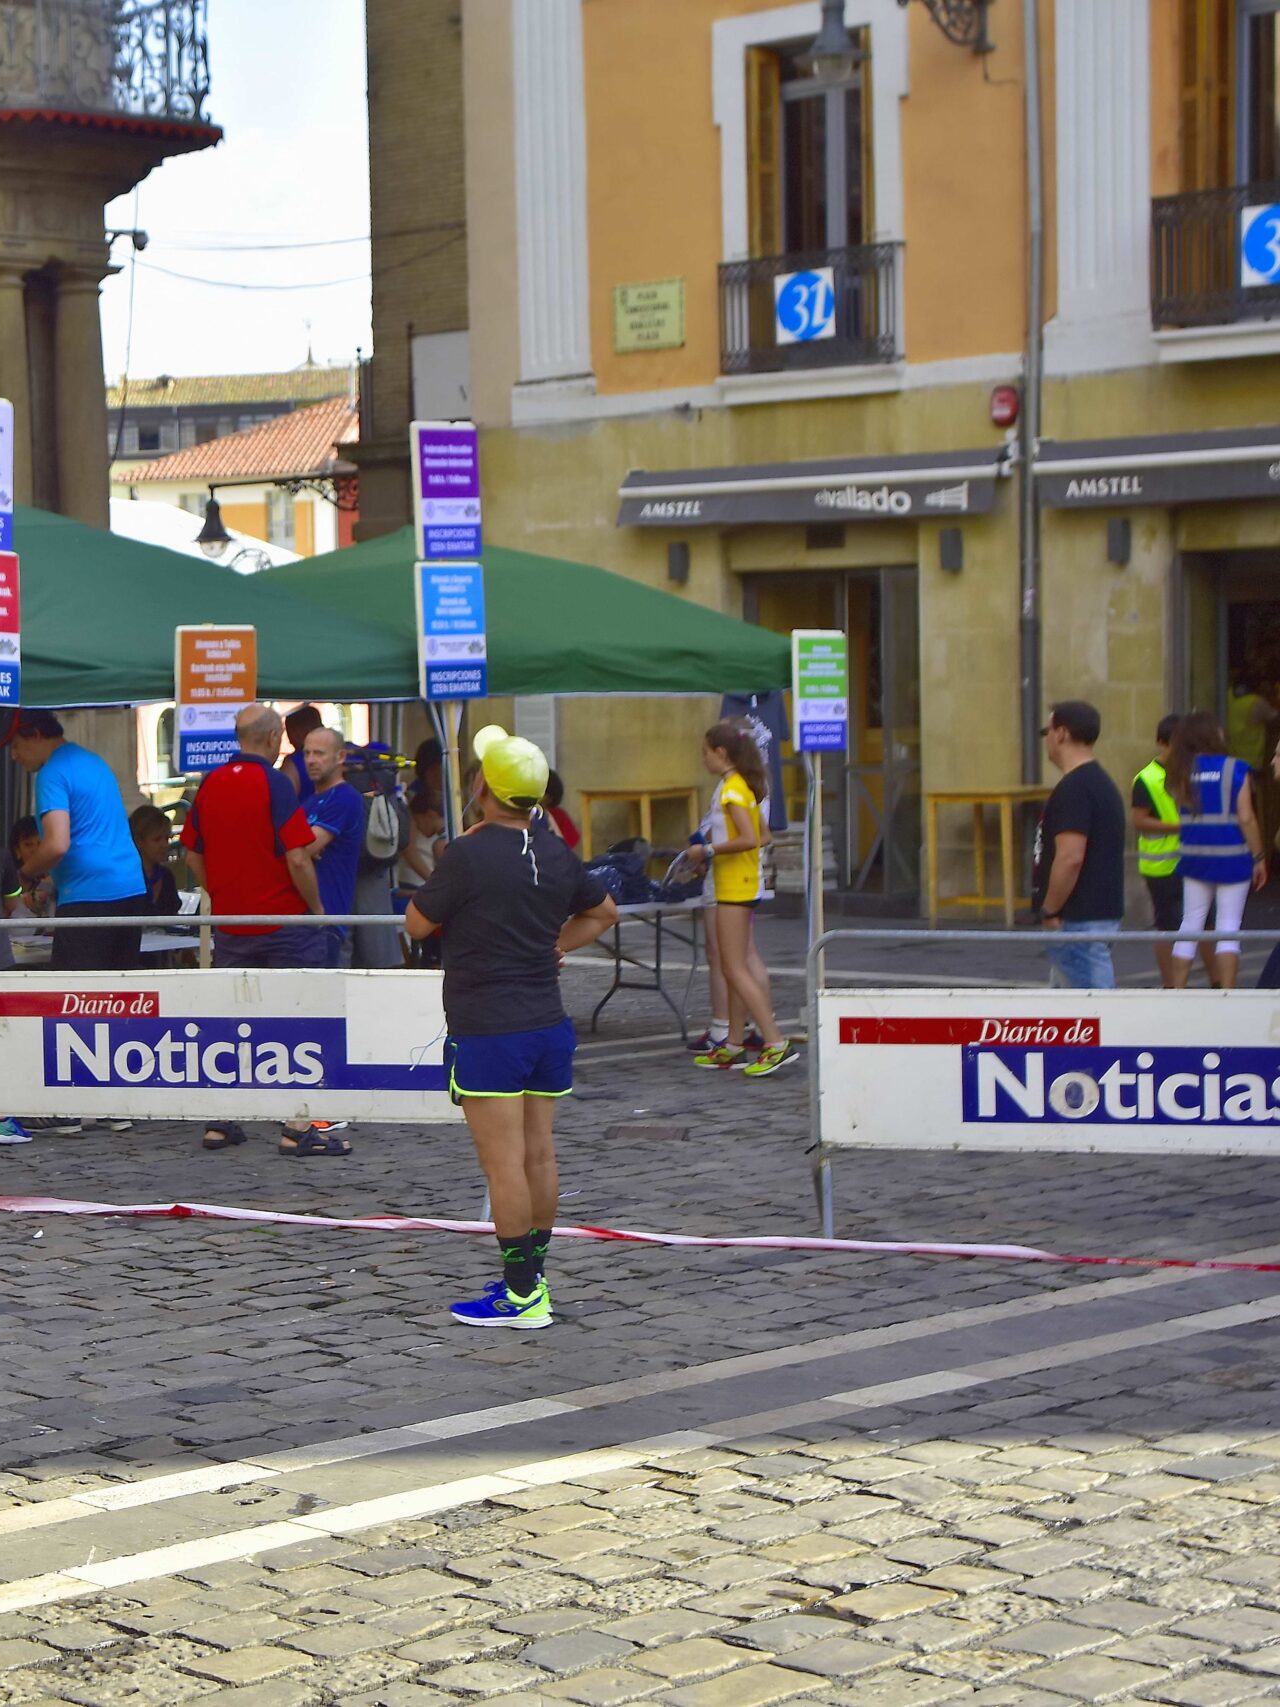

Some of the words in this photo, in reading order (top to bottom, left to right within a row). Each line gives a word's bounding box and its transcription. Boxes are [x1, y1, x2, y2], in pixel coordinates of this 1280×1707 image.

[791, 281, 829, 336] 31
[1066, 476, 1143, 498] AMSTEL
[640, 500, 702, 518] AMSTEL
[186, 740, 241, 753] INSCRIPCION
[187, 754, 207, 766] IZEN
[61, 992, 125, 1015] Diario
[129, 992, 154, 1015] de
[979, 1018, 1059, 1044] Diario
[1063, 1017, 1094, 1043] de
[56, 1022, 325, 1085] Noticias
